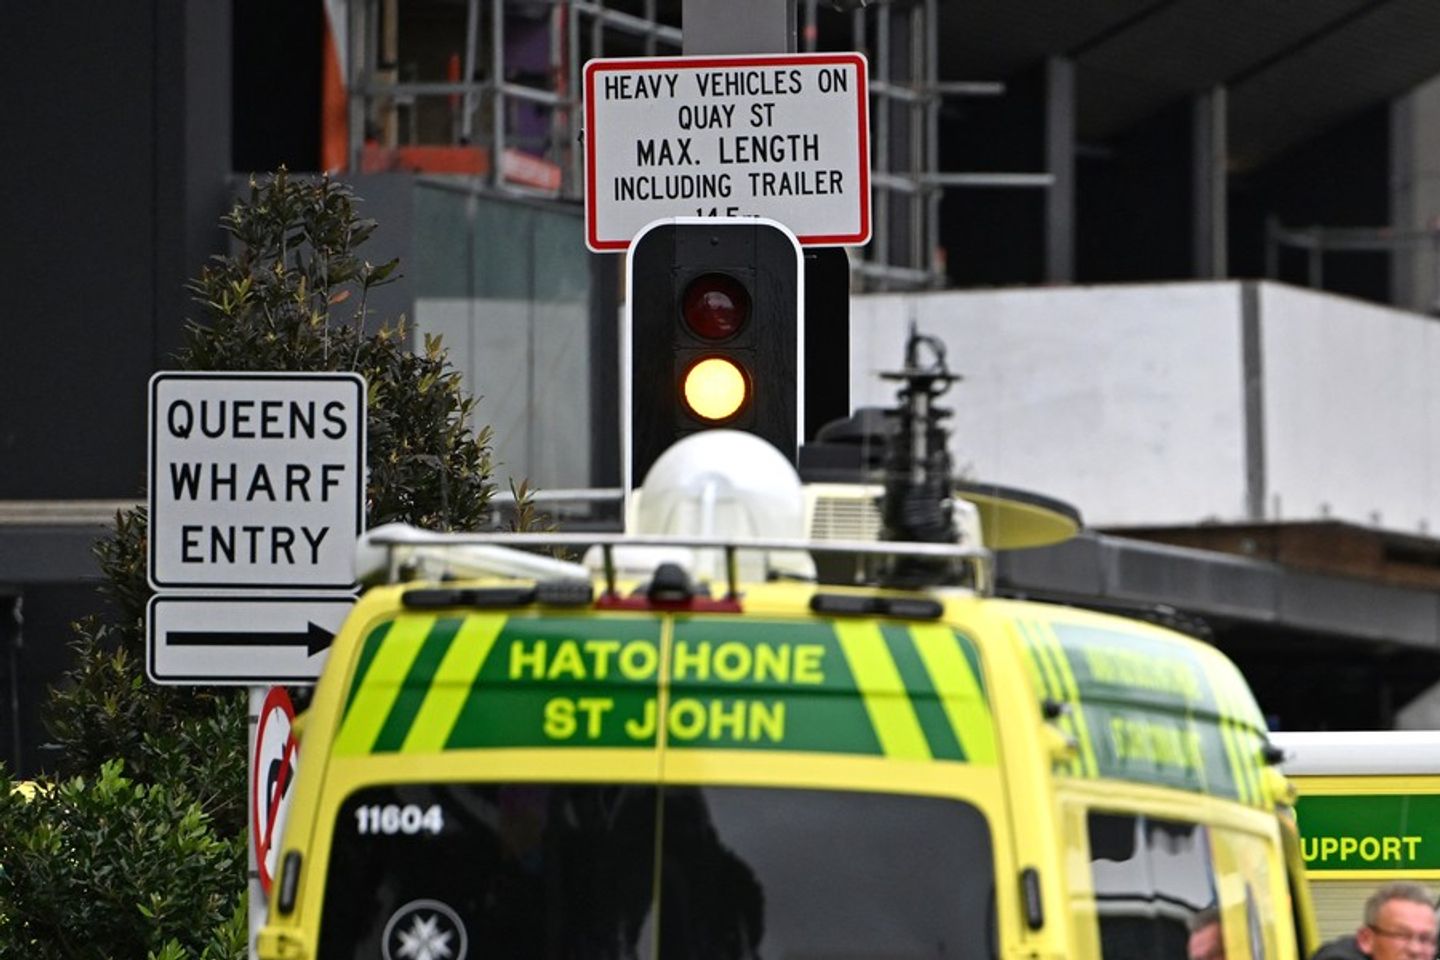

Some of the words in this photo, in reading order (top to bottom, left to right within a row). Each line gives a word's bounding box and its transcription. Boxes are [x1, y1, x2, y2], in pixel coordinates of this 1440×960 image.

[605, 73, 679, 101] HEAVY
[696, 69, 803, 97] VEHICLES
[818, 68, 848, 94] ON
[678, 104, 736, 131] QUAY
[750, 103, 776, 128] ST
[636, 138, 701, 167] MAX.
[719, 134, 819, 164] LENGTH
[614, 174, 732, 201] INCLUDING
[749, 170, 843, 197] TRAILER
[167, 399, 348, 441] QUEENS
[170, 463, 346, 502] WHARF
[181, 525, 330, 564] ENTRY
[509, 639, 659, 681] HATO
[672, 640, 826, 685] HONE
[543, 697, 614, 739] ST
[625, 697, 786, 742] JOHN
[355, 803, 444, 835] 11604
[1300, 836, 1422, 861] UPPORT
